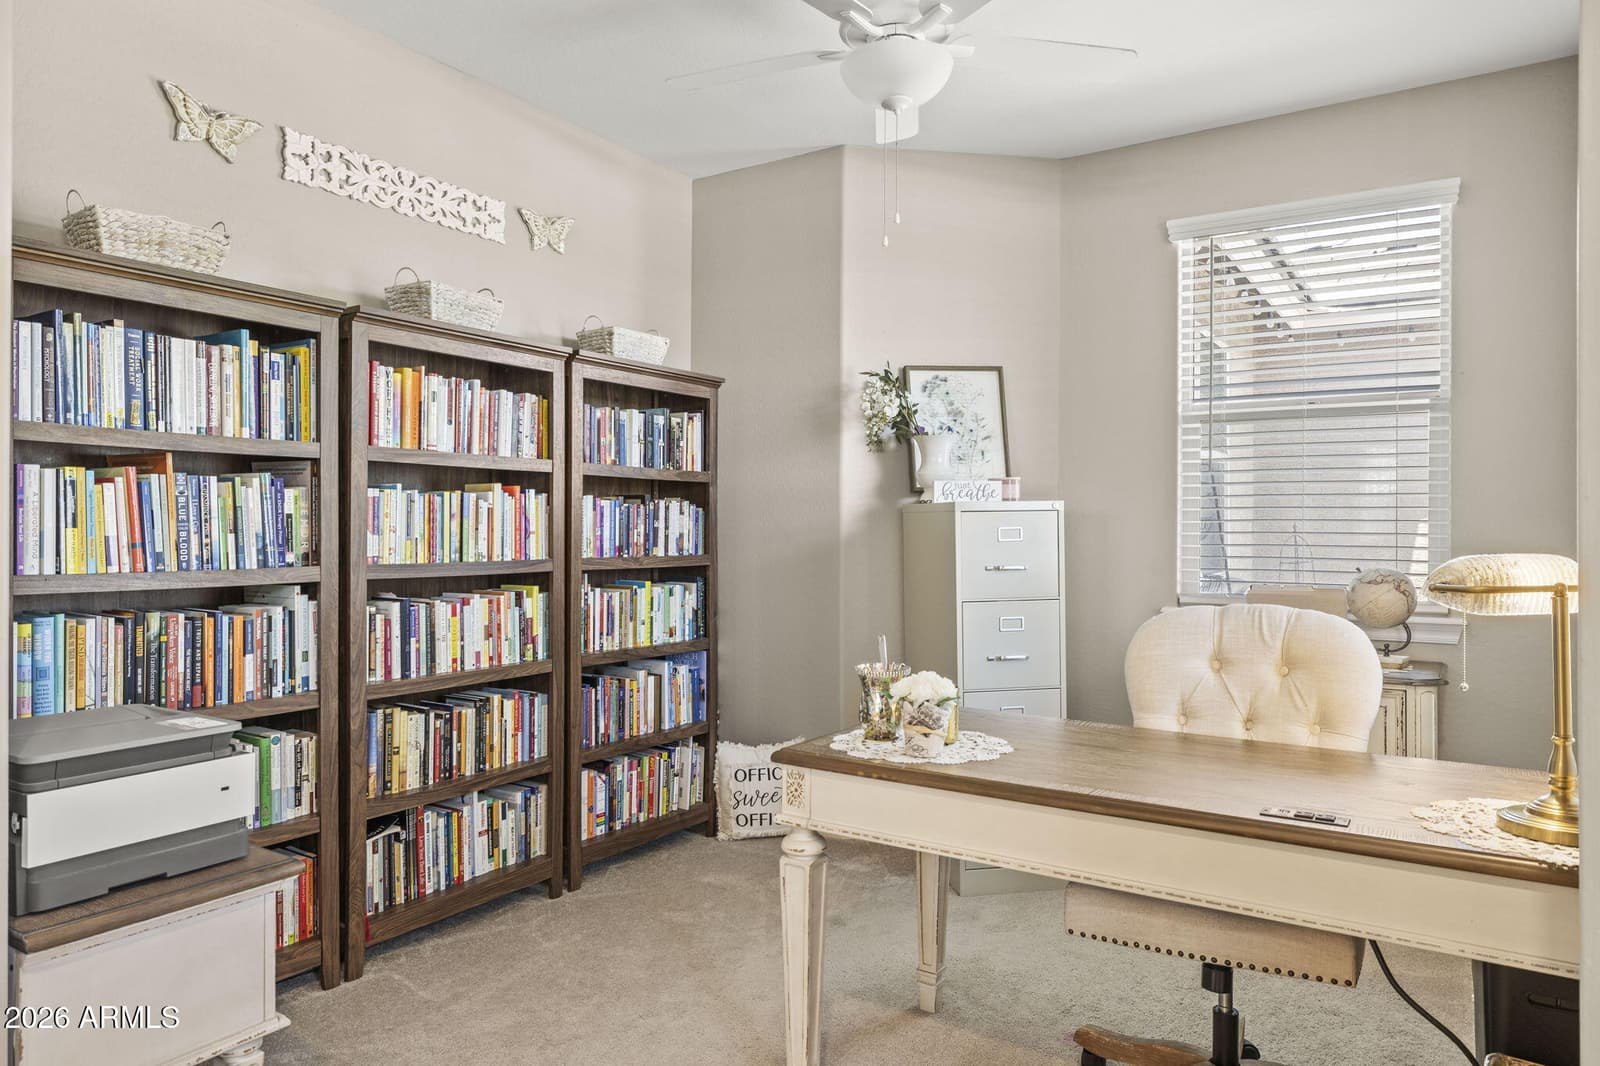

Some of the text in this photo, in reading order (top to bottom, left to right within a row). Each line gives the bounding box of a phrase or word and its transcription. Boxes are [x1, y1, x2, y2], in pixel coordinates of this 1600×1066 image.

[942, 480, 999, 502] breathe
[32, 500, 40, 537] Liberated
[178, 497, 188, 561] BLUE BLOOD
[167, 617, 177, 664] Unspoken Voice
[150, 642, 158, 701] The Transformation
[735, 812, 779, 827] OFFI
